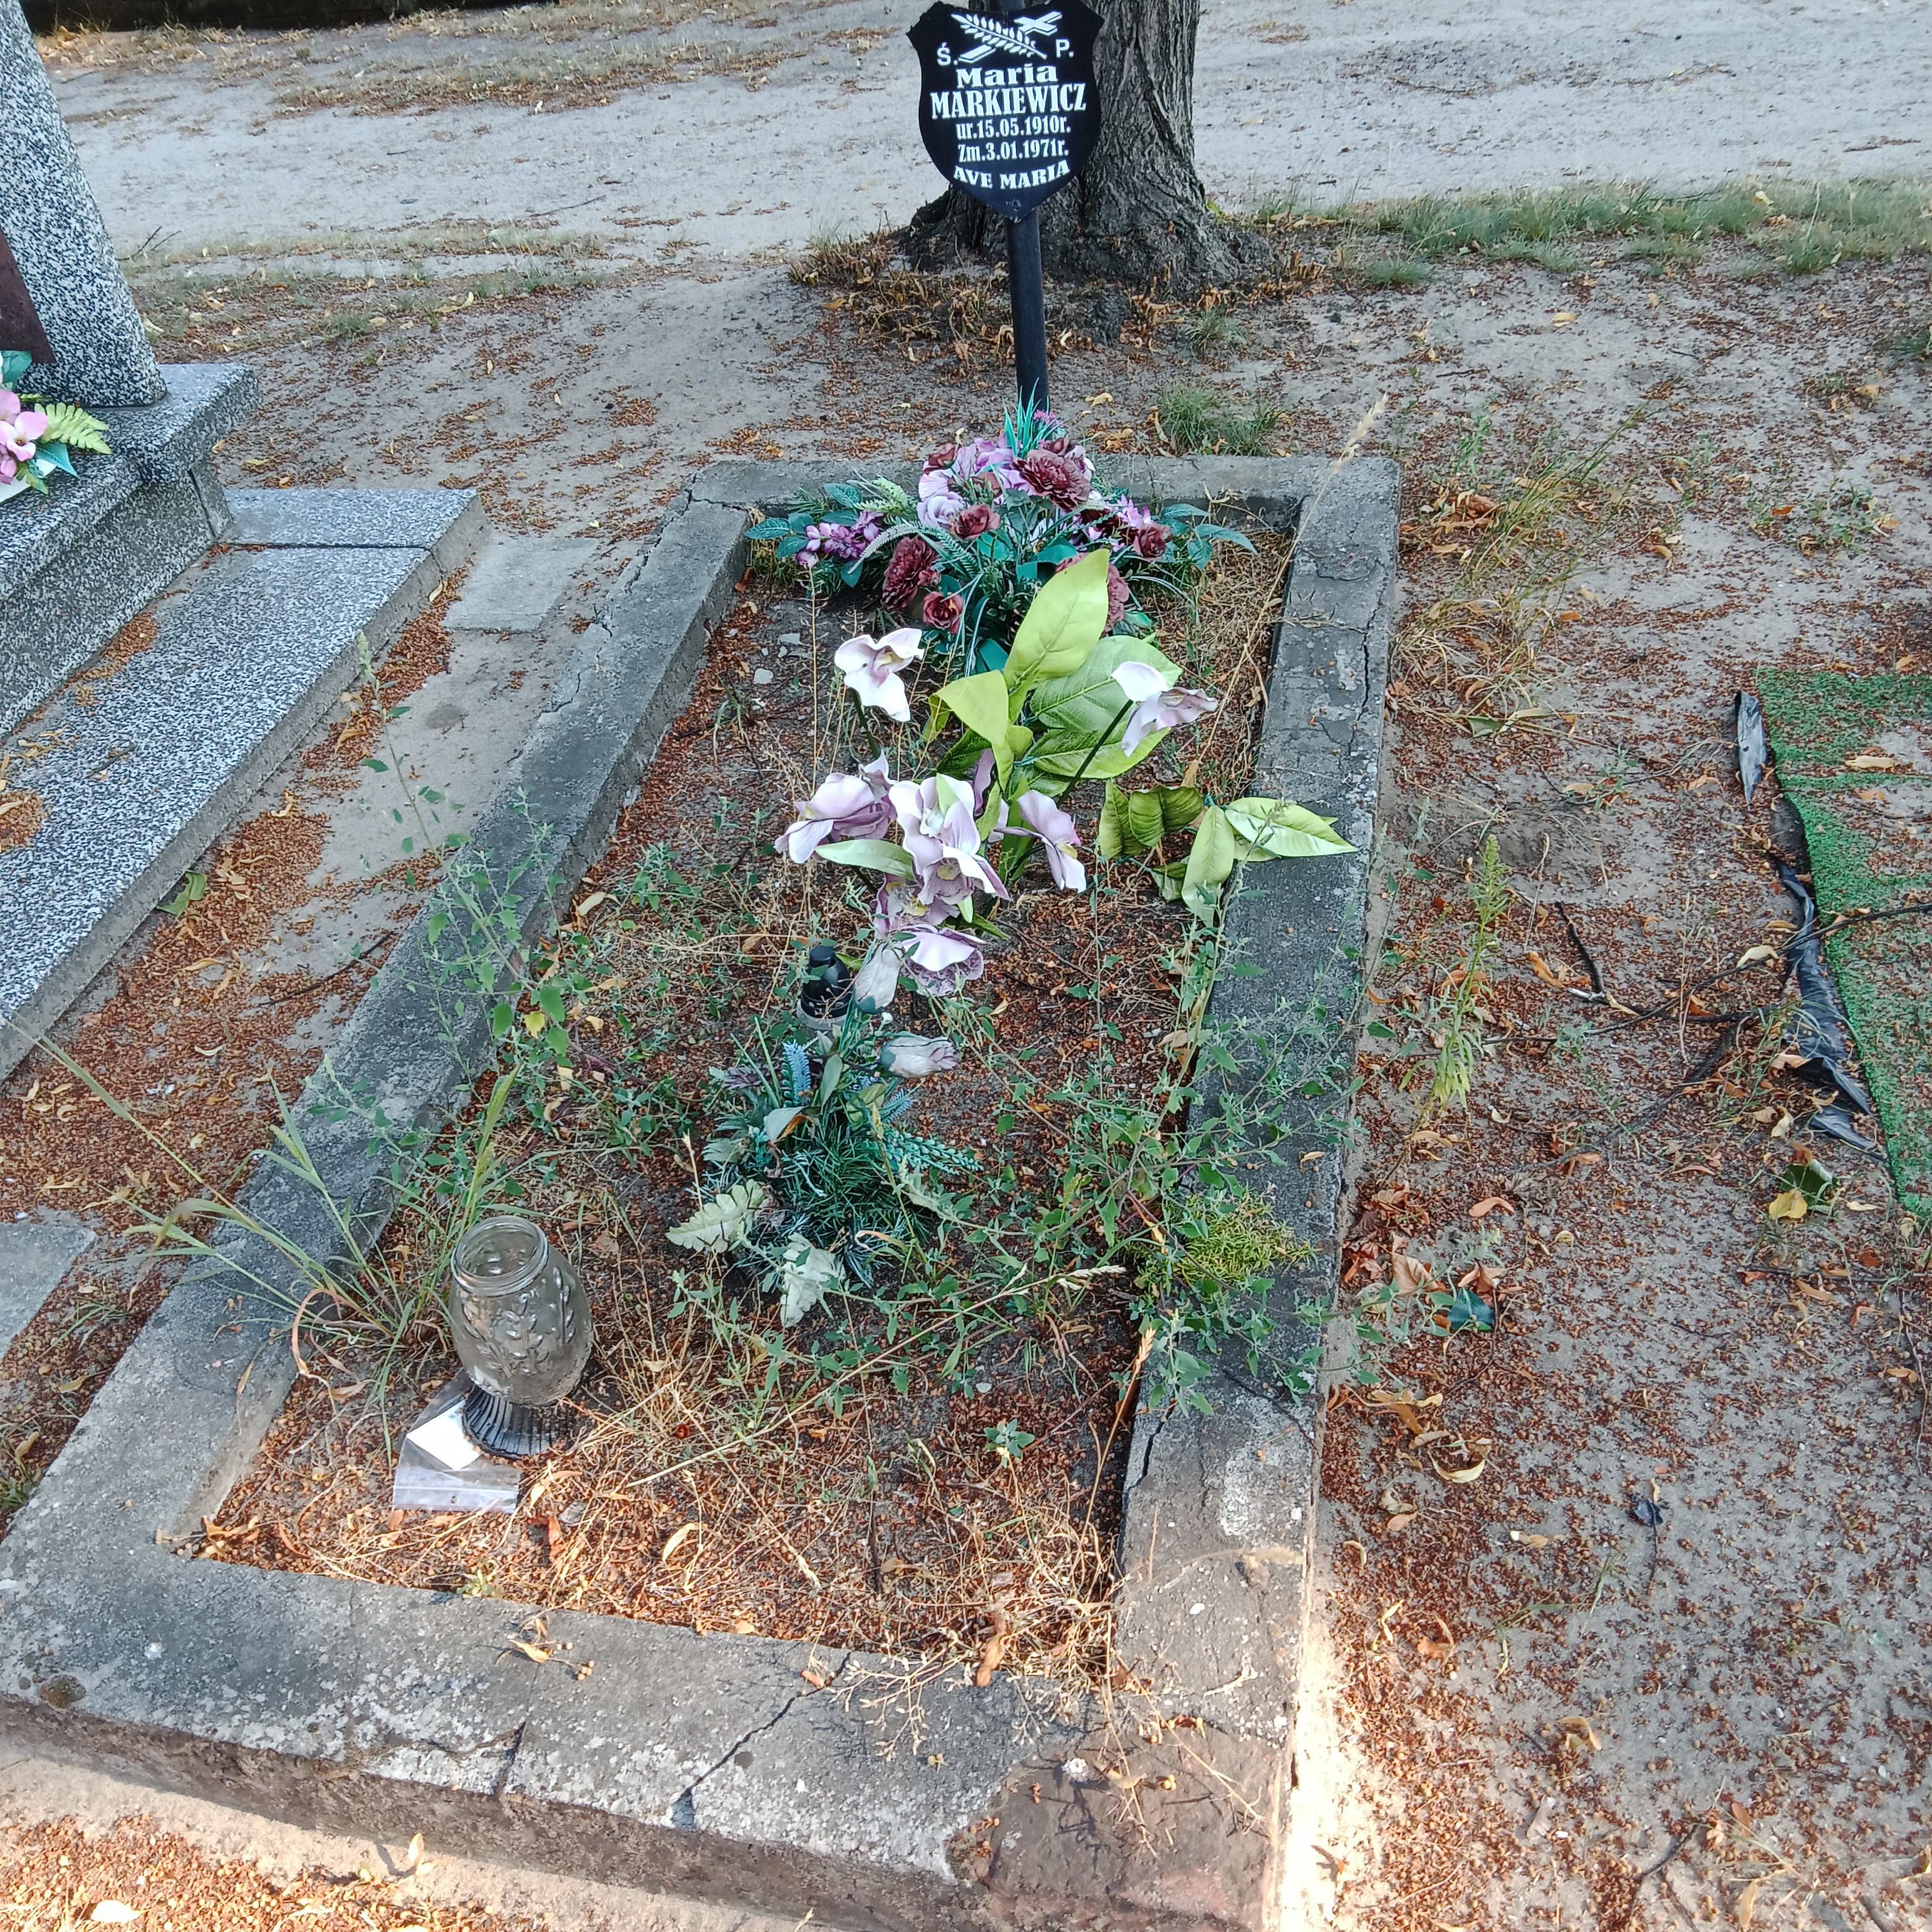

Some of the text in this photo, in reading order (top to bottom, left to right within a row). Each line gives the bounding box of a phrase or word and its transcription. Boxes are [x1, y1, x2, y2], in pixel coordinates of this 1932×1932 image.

[937, 38, 1074, 66] Ś. P.
[955, 63, 1058, 89] Maria
[930, 82, 1087, 120] MARKIEWICZ
[955, 115, 1071, 140] ur.15.05.1910r.
[958, 138, 1069, 163] Zm.3.01.1971r.
[954, 159, 1070, 189] AVE MARIA
